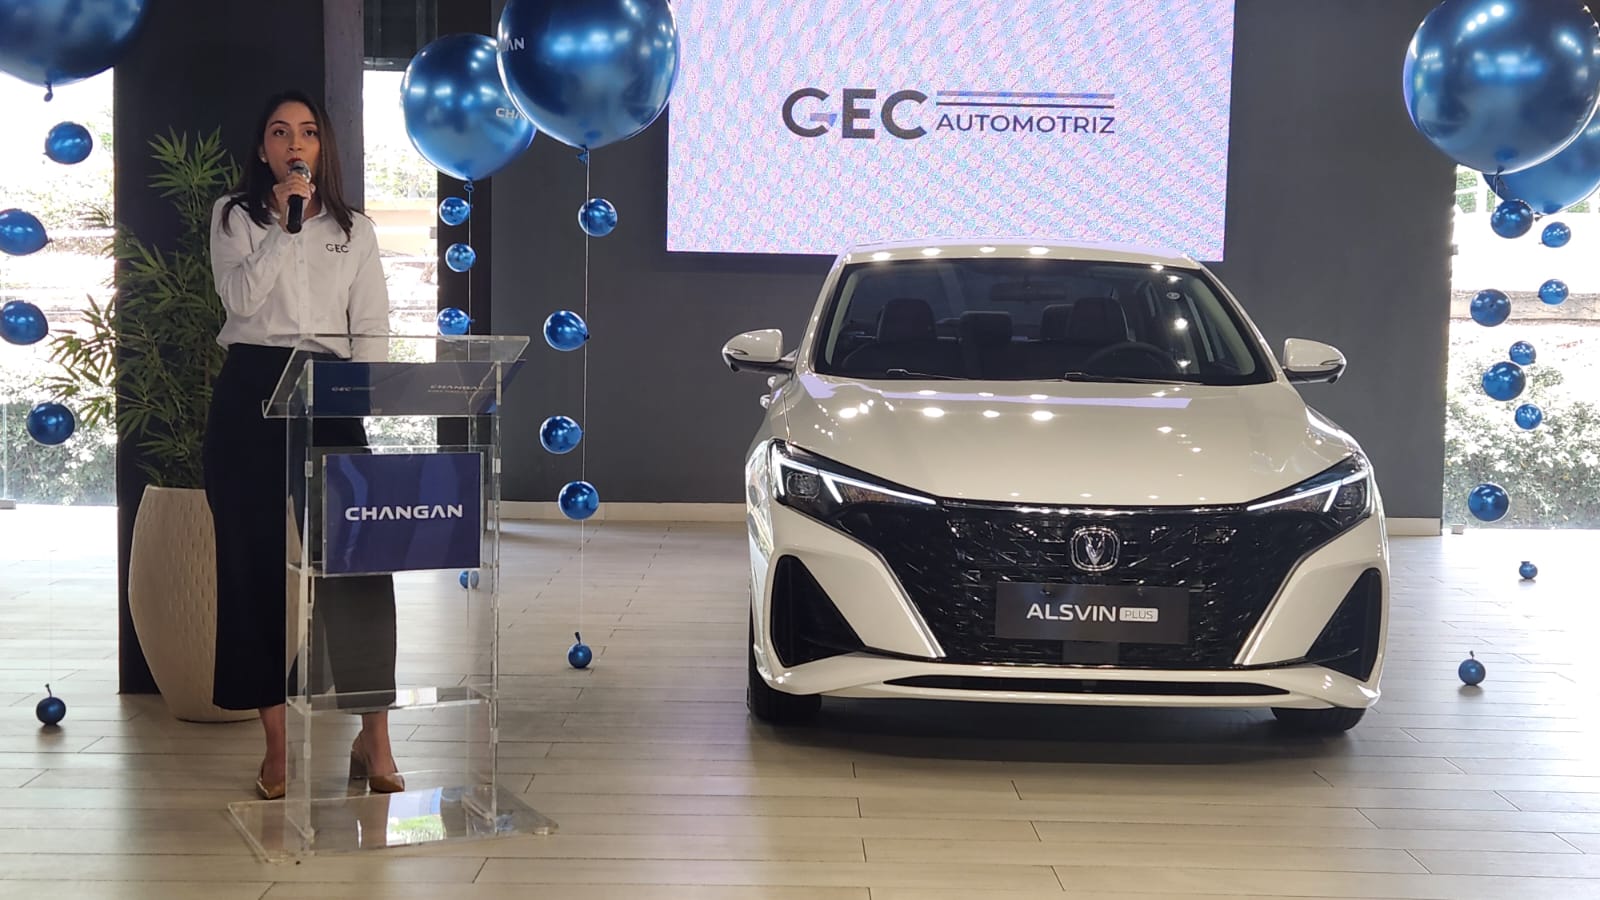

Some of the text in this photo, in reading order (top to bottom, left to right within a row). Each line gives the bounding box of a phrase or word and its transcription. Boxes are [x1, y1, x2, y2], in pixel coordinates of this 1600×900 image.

[782, 87, 1115, 140] GEC AUTOMOTRIZ
[325, 243, 349, 253] GEC
[345, 504, 463, 520] CHANGAN
[1026, 603, 1154, 622] ALSVIN PLUS
